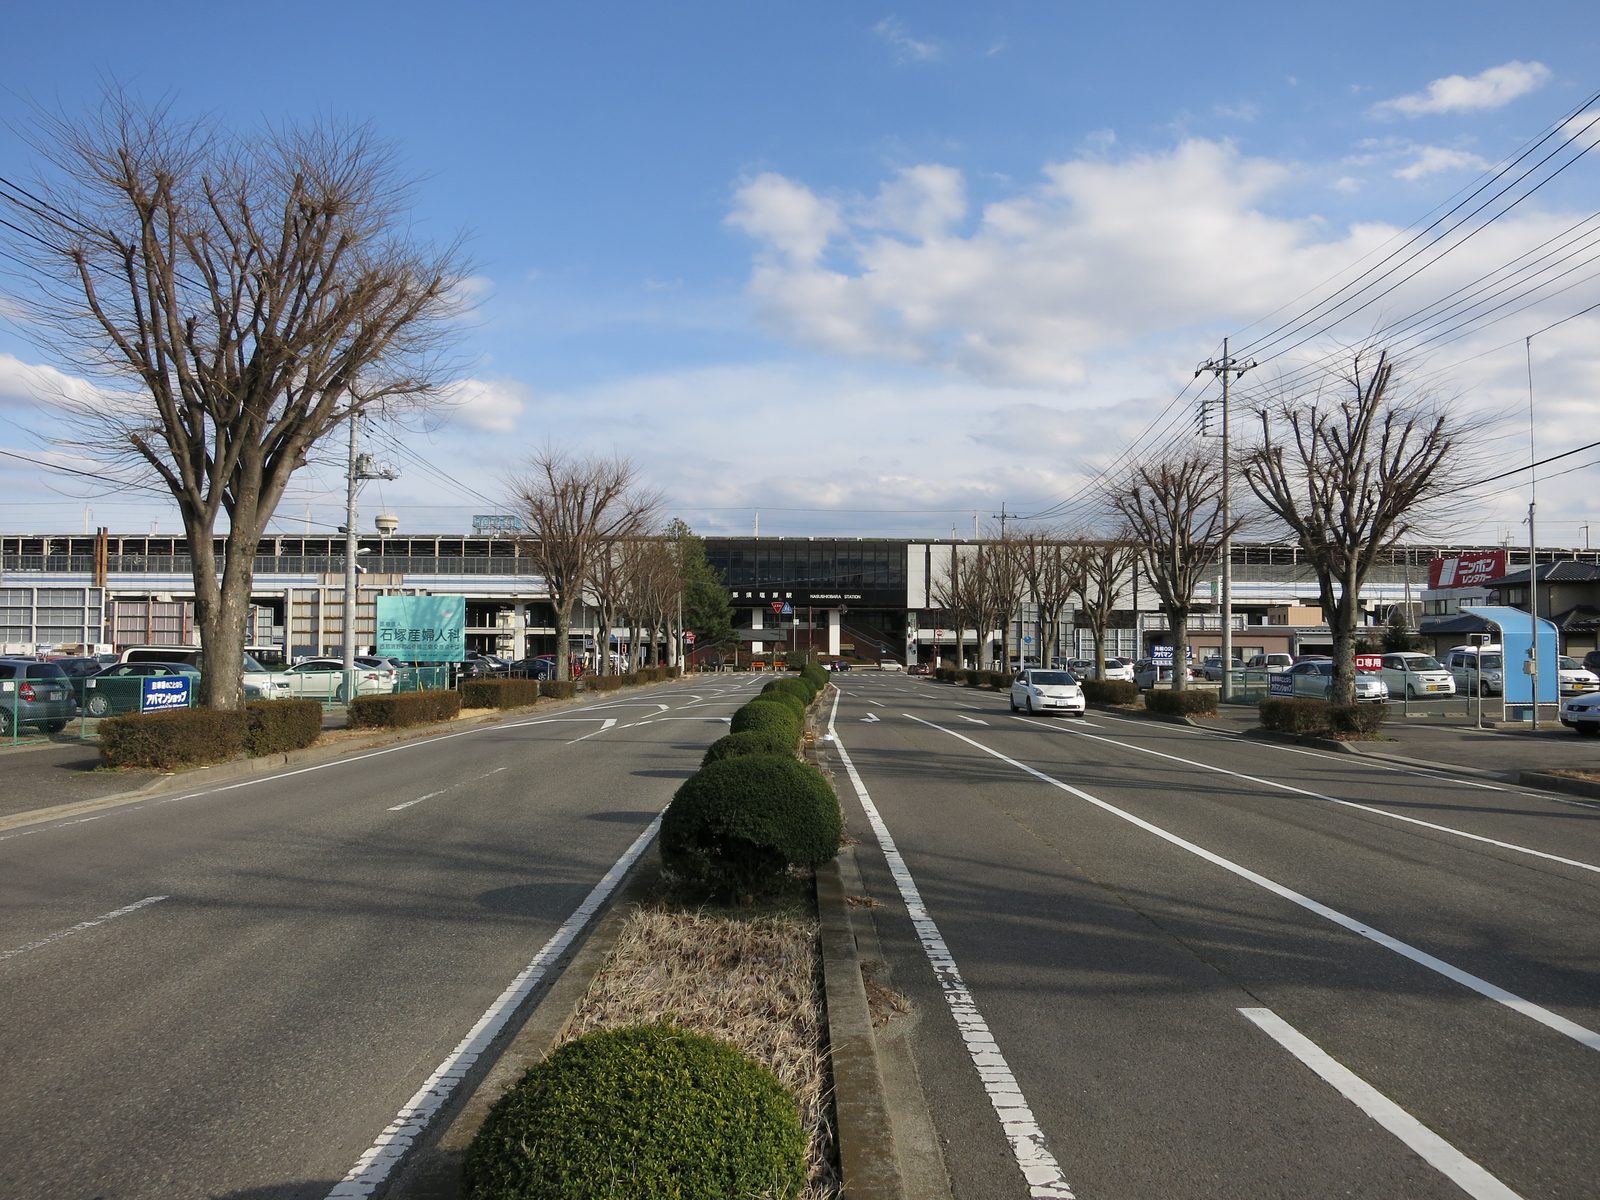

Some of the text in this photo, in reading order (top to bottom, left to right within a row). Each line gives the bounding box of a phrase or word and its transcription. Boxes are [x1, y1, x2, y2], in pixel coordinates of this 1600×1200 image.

[1459, 559, 1496, 575] ニッポン
[1462, 574, 1492, 584] レンタカー
[380, 628, 460, 642] 石塚産婦人科
[1482, 635, 1490, 645] P
[1356, 658, 1382, 667] 口専用
[146, 690, 187, 705] アパマンショップ
